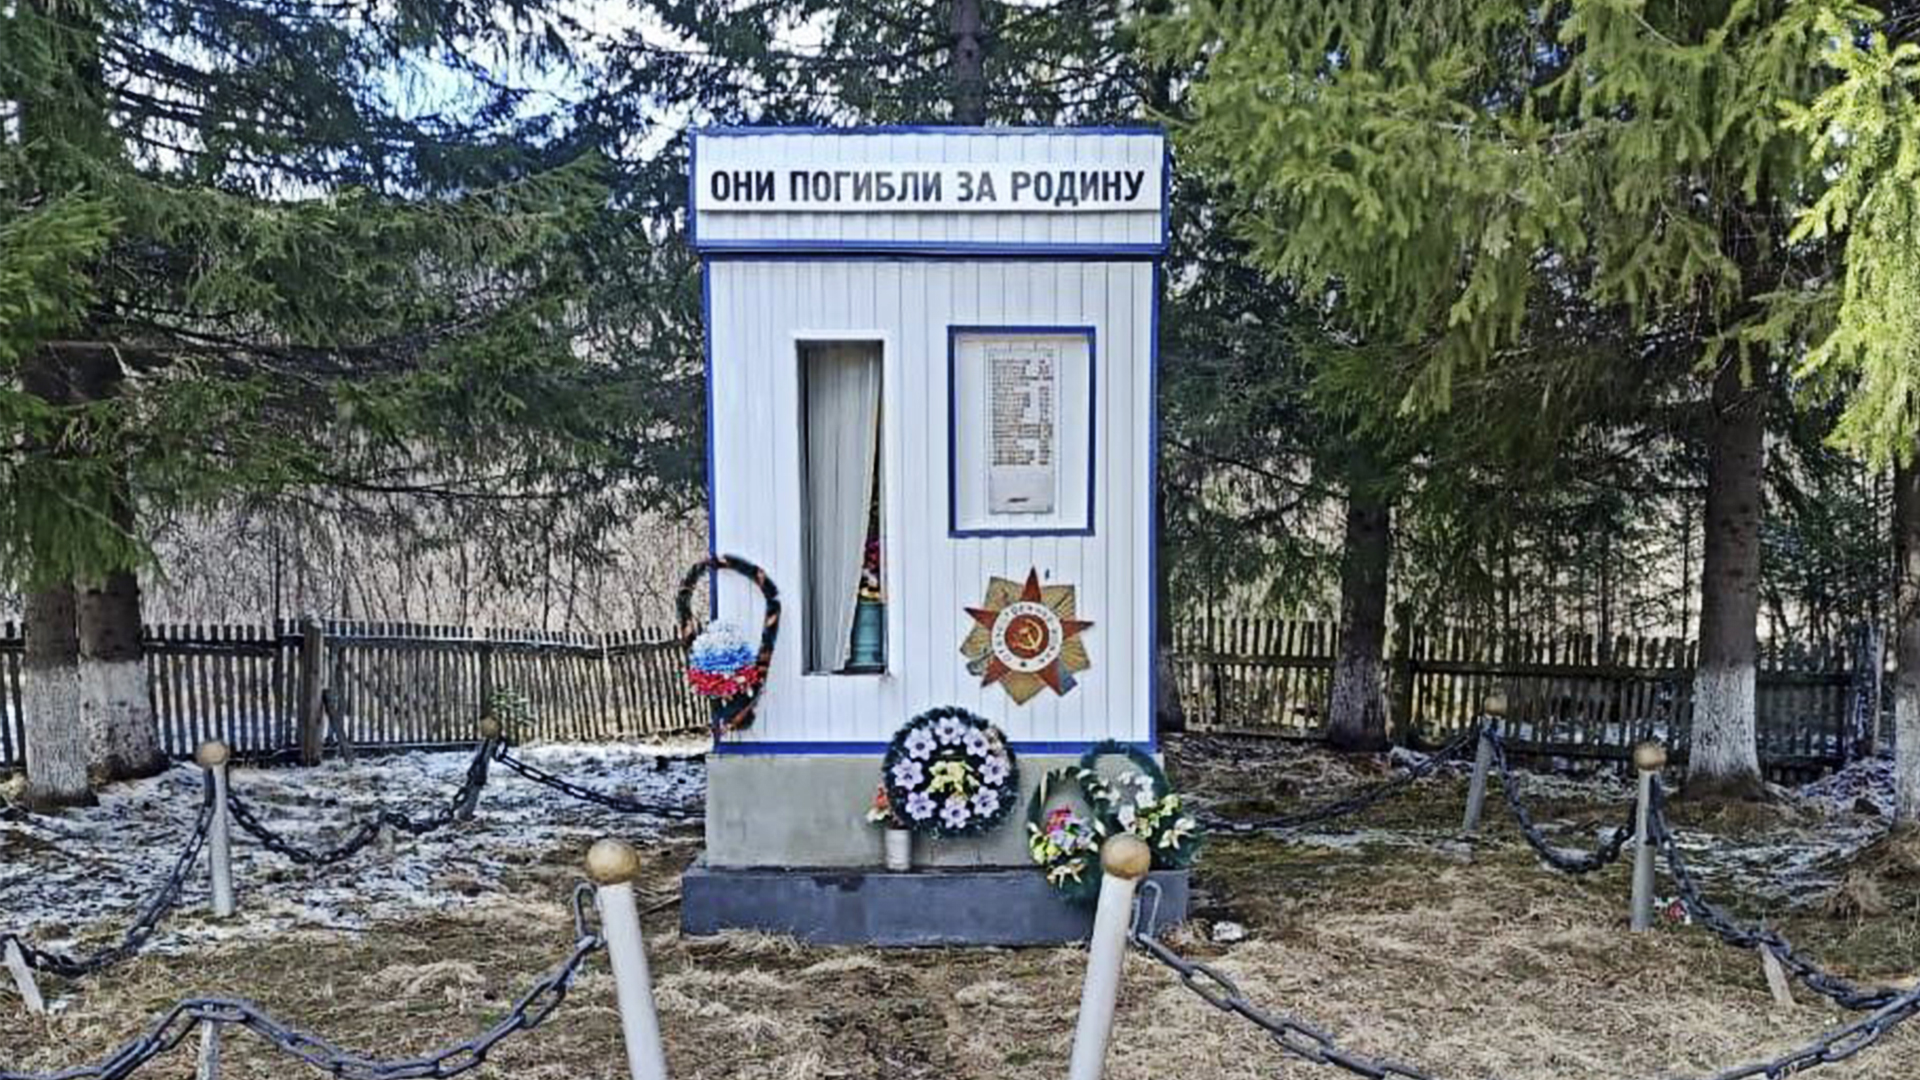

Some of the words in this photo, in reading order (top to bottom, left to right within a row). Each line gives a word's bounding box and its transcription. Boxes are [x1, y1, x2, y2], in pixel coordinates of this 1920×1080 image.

[711, 170, 774, 201] ОНИ
[789, 170, 941, 201] ПОГИБЛИ
[957, 170, 996, 201] ЗА
[1011, 170, 1144, 206] РОДИНУ
